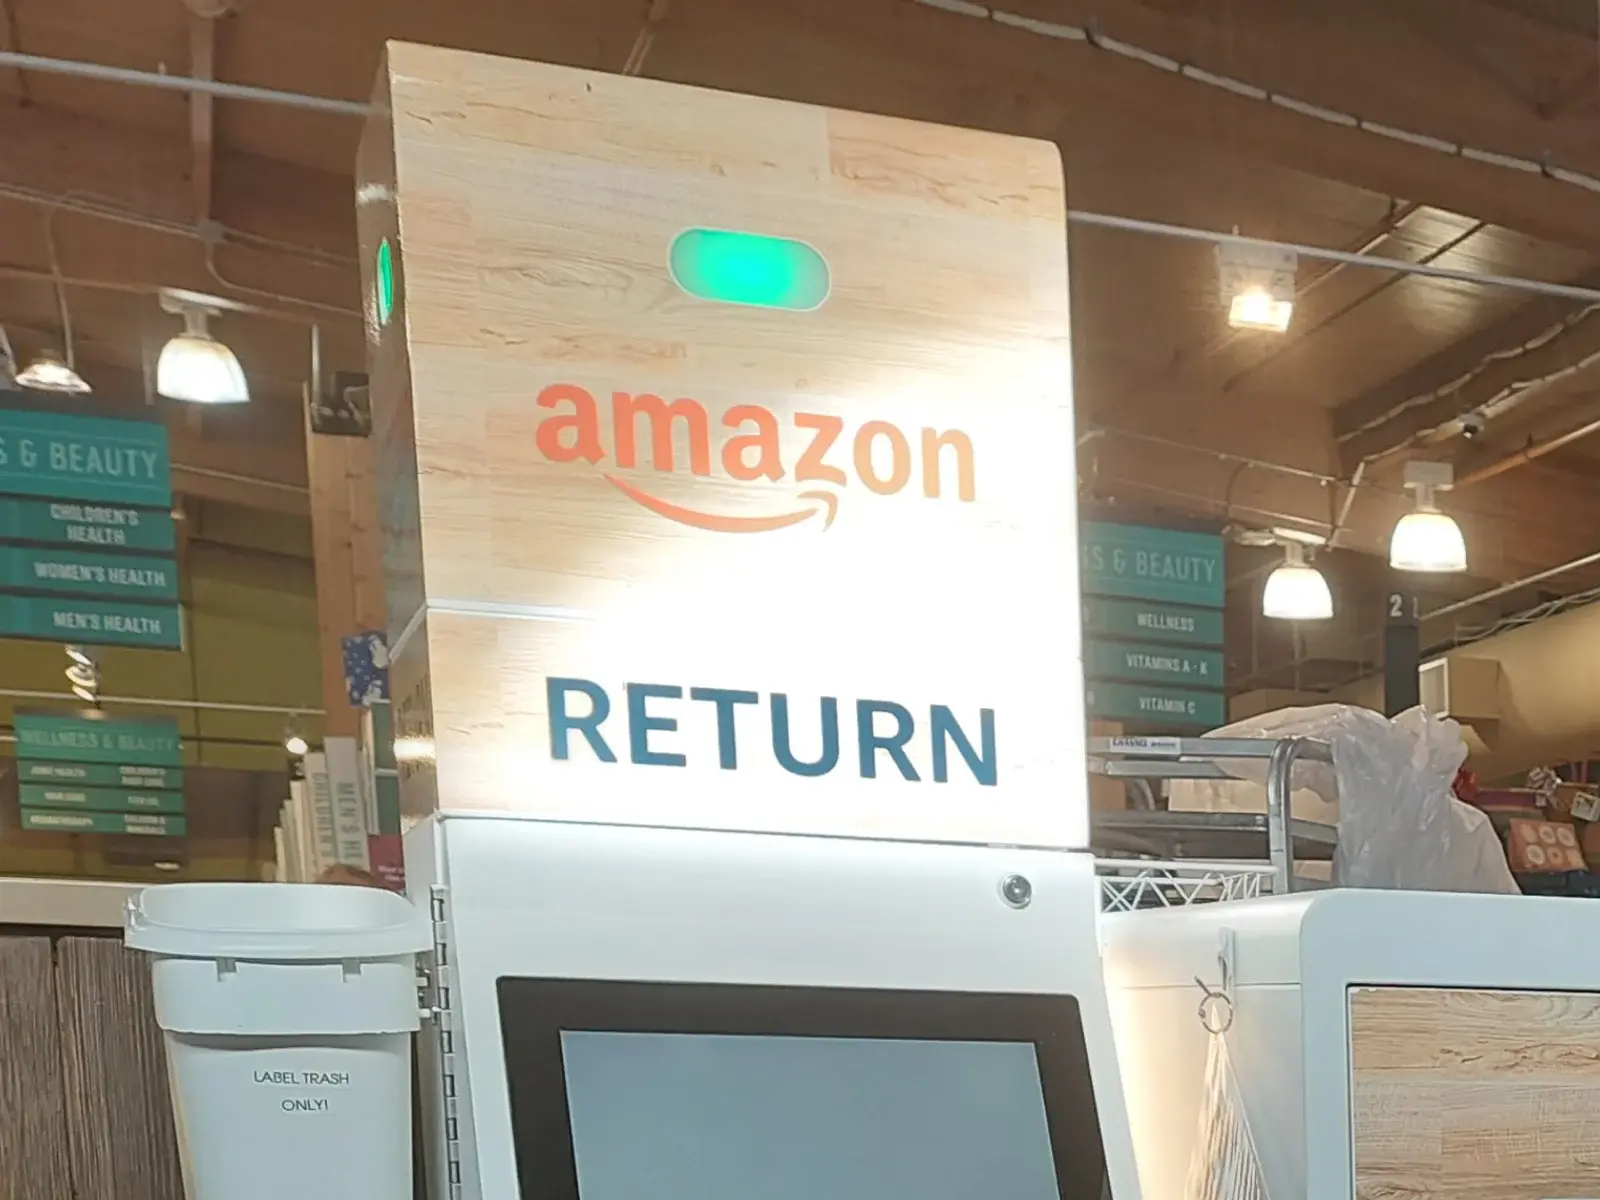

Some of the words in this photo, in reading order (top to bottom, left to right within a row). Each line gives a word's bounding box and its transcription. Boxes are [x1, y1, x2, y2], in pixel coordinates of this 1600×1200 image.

[535, 383, 975, 502] amazon
[20, 439, 37, 468] &
[50, 441, 157, 479] BEAUTY
[66, 525, 126, 545] HEALTH
[33, 562, 105, 583] WOMEN'S
[108, 567, 166, 587] HEALTH
[1113, 548, 1126, 575] &
[1136, 550, 1216, 584] BEAUTY
[1390, 594, 1403, 617] 2
[53, 611, 101, 631] MEN'S
[103, 616, 161, 635] HEALTH
[1137, 613, 1195, 633] WELLNESS
[1125, 653, 1180, 673] VITAMINS
[1182, 661, 1191, 673] A
[1139, 697, 1186, 715] VITAMIN
[1187, 701, 1196, 716] C
[545, 676, 998, 786] RETURN
[254, 1070, 300, 1085] LABEL
[302, 1072, 349, 1085] TRASH
[281, 1099, 328, 1112] ONLY!
